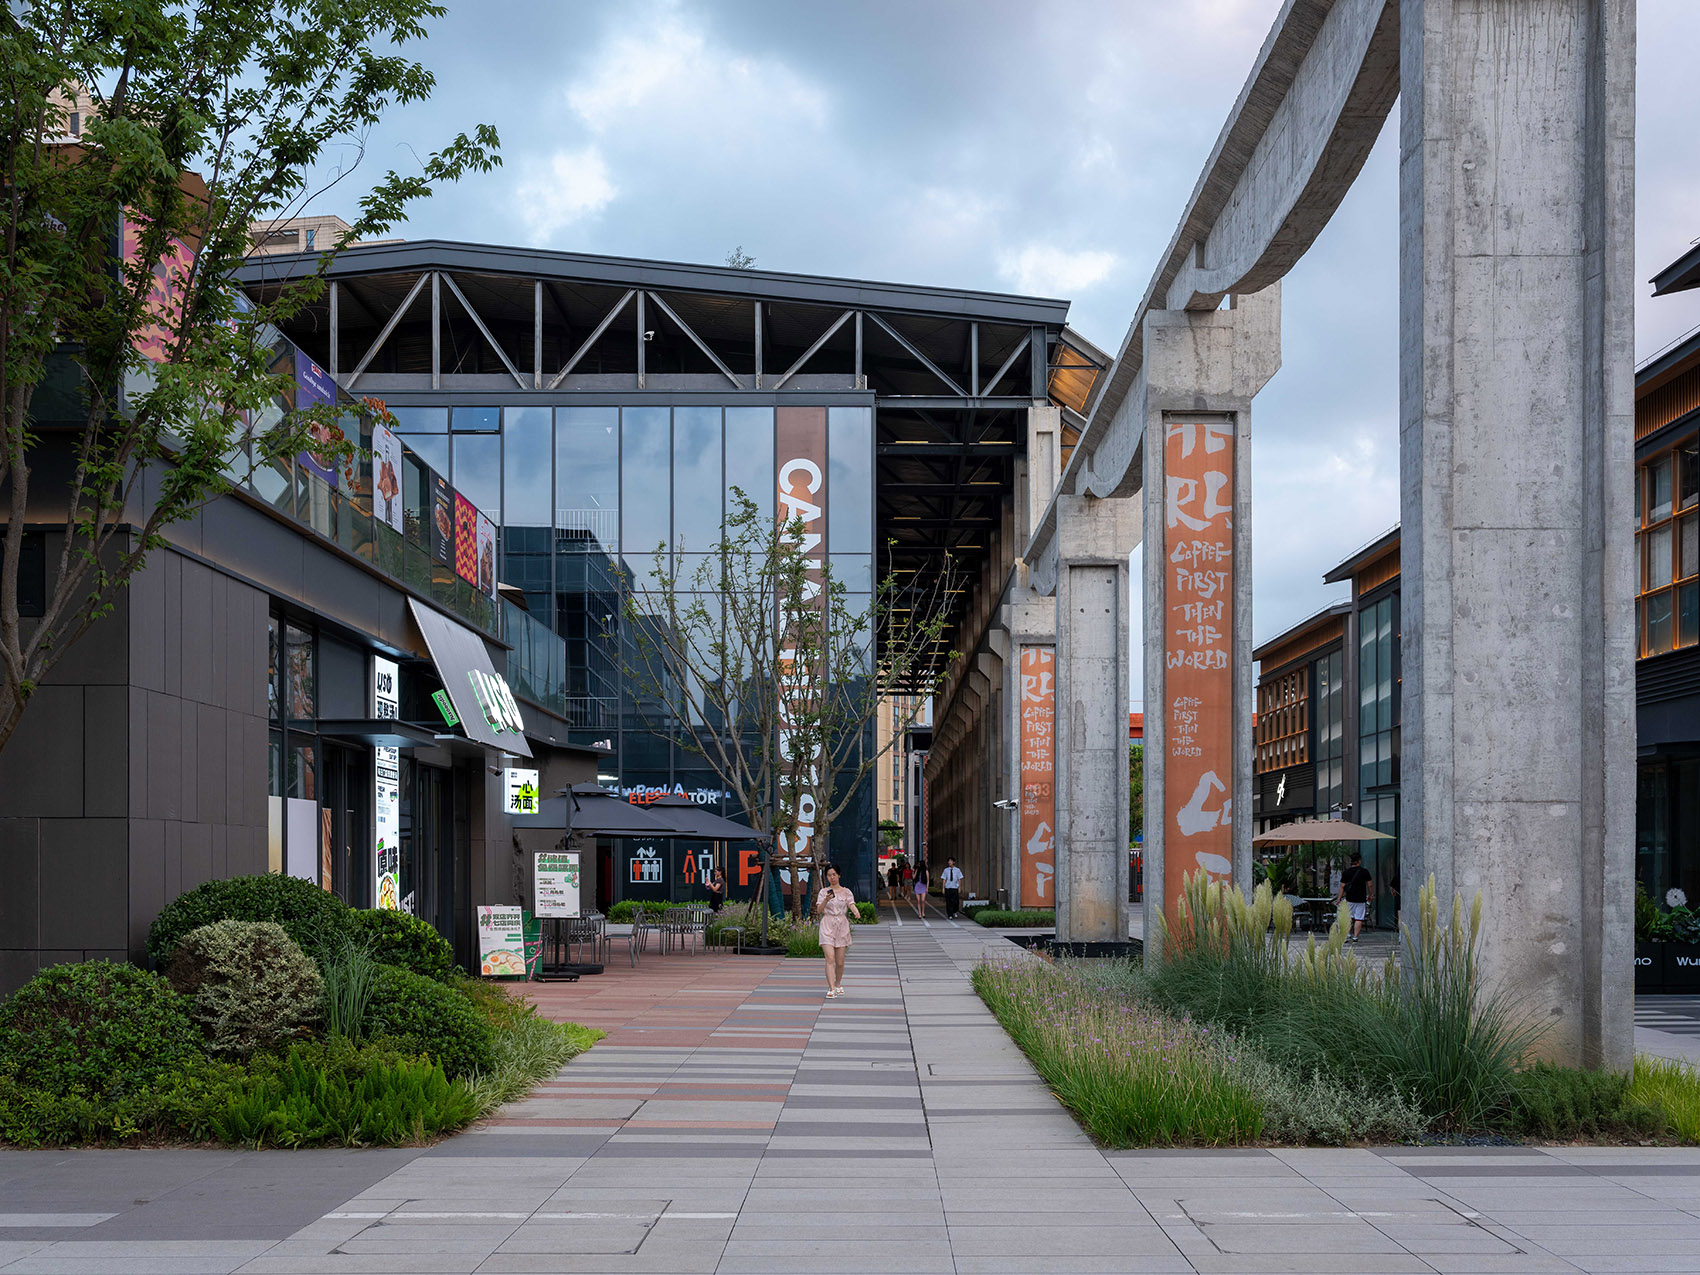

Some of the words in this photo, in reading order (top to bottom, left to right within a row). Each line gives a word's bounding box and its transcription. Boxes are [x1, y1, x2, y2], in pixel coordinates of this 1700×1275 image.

[1170, 540, 1232, 568] COFFEE
[1176, 568, 1228, 598] FIRST
[1172, 600, 1224, 623] THEN
[1176, 625, 1222, 646] THE
[1167, 649, 1227, 670] WORLD
[1174, 709, 1198, 724] FIRST
[1026, 720, 1052, 736] FIRST
[1172, 747, 1202, 757] WORLD
[1021, 761, 1052, 771] WORLD
[511, 780, 533, 794] 一心
[511, 795, 533, 810] 汤面
[629, 792, 718, 805] ELEATOR
[1676, 956, 1700, 967] Wu
